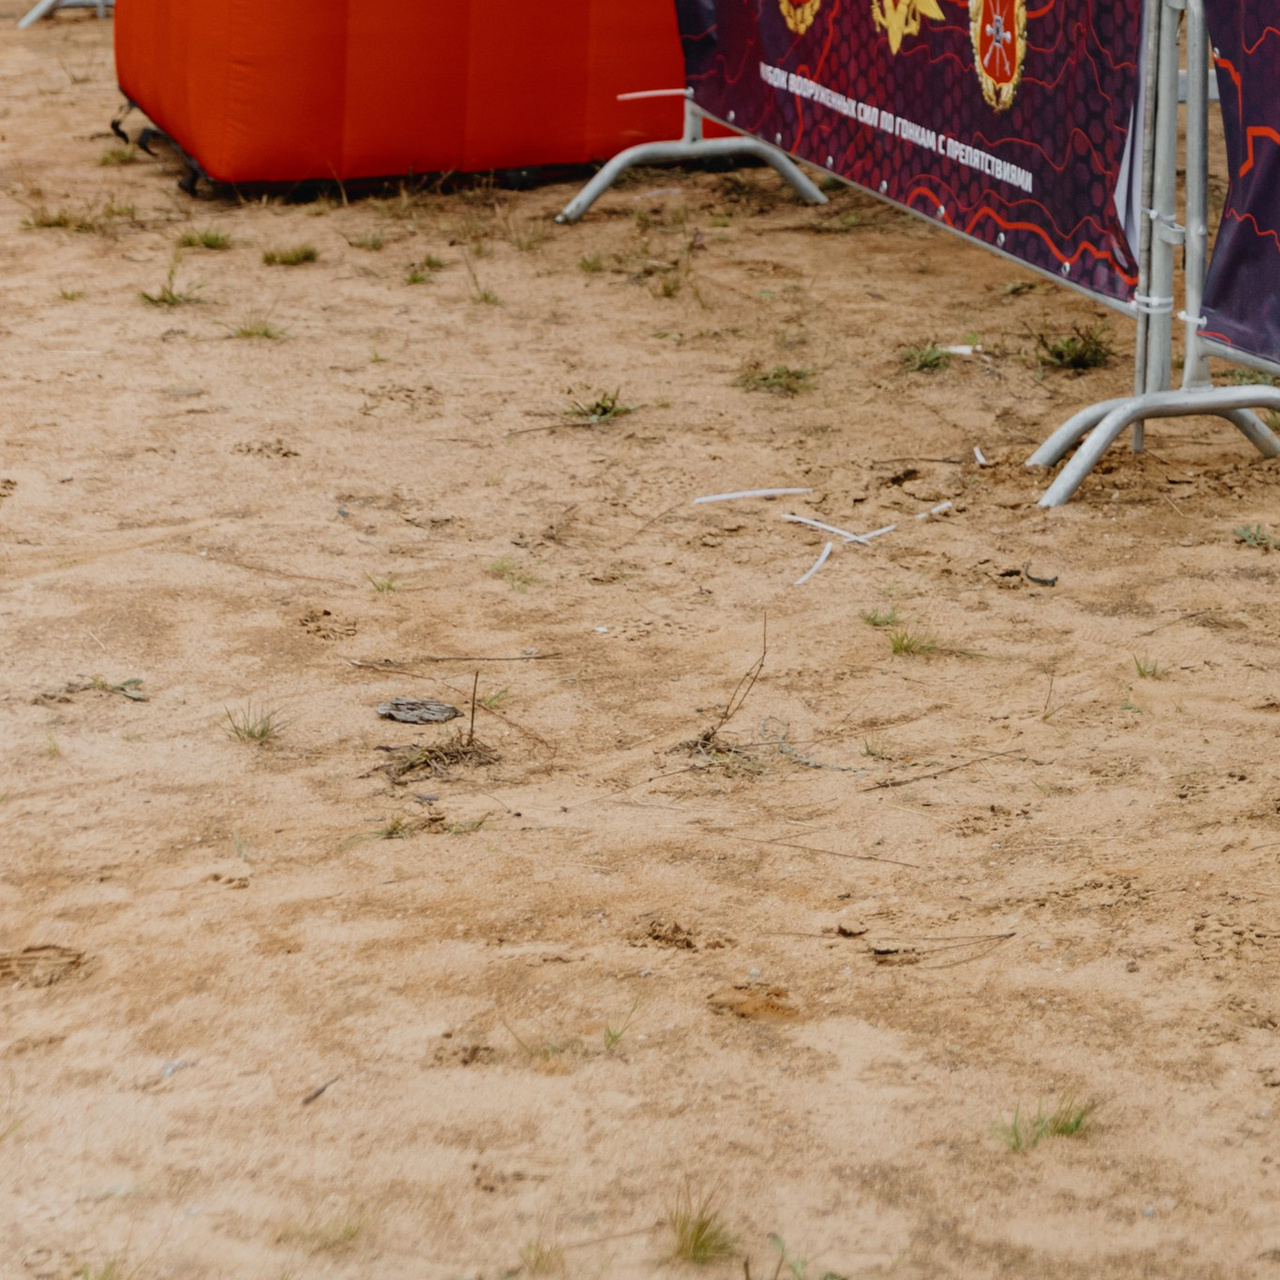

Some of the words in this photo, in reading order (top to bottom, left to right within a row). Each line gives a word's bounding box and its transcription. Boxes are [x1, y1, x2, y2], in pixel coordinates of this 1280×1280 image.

[857, 102, 879, 128] СИЛ
[880, 110, 894, 134] ПО
[894, 116, 936, 152] ГОНКАМ
[938, 133, 945, 156] С
[946, 137, 1033, 194] ПРЕПЯТСТВИЯМИ
